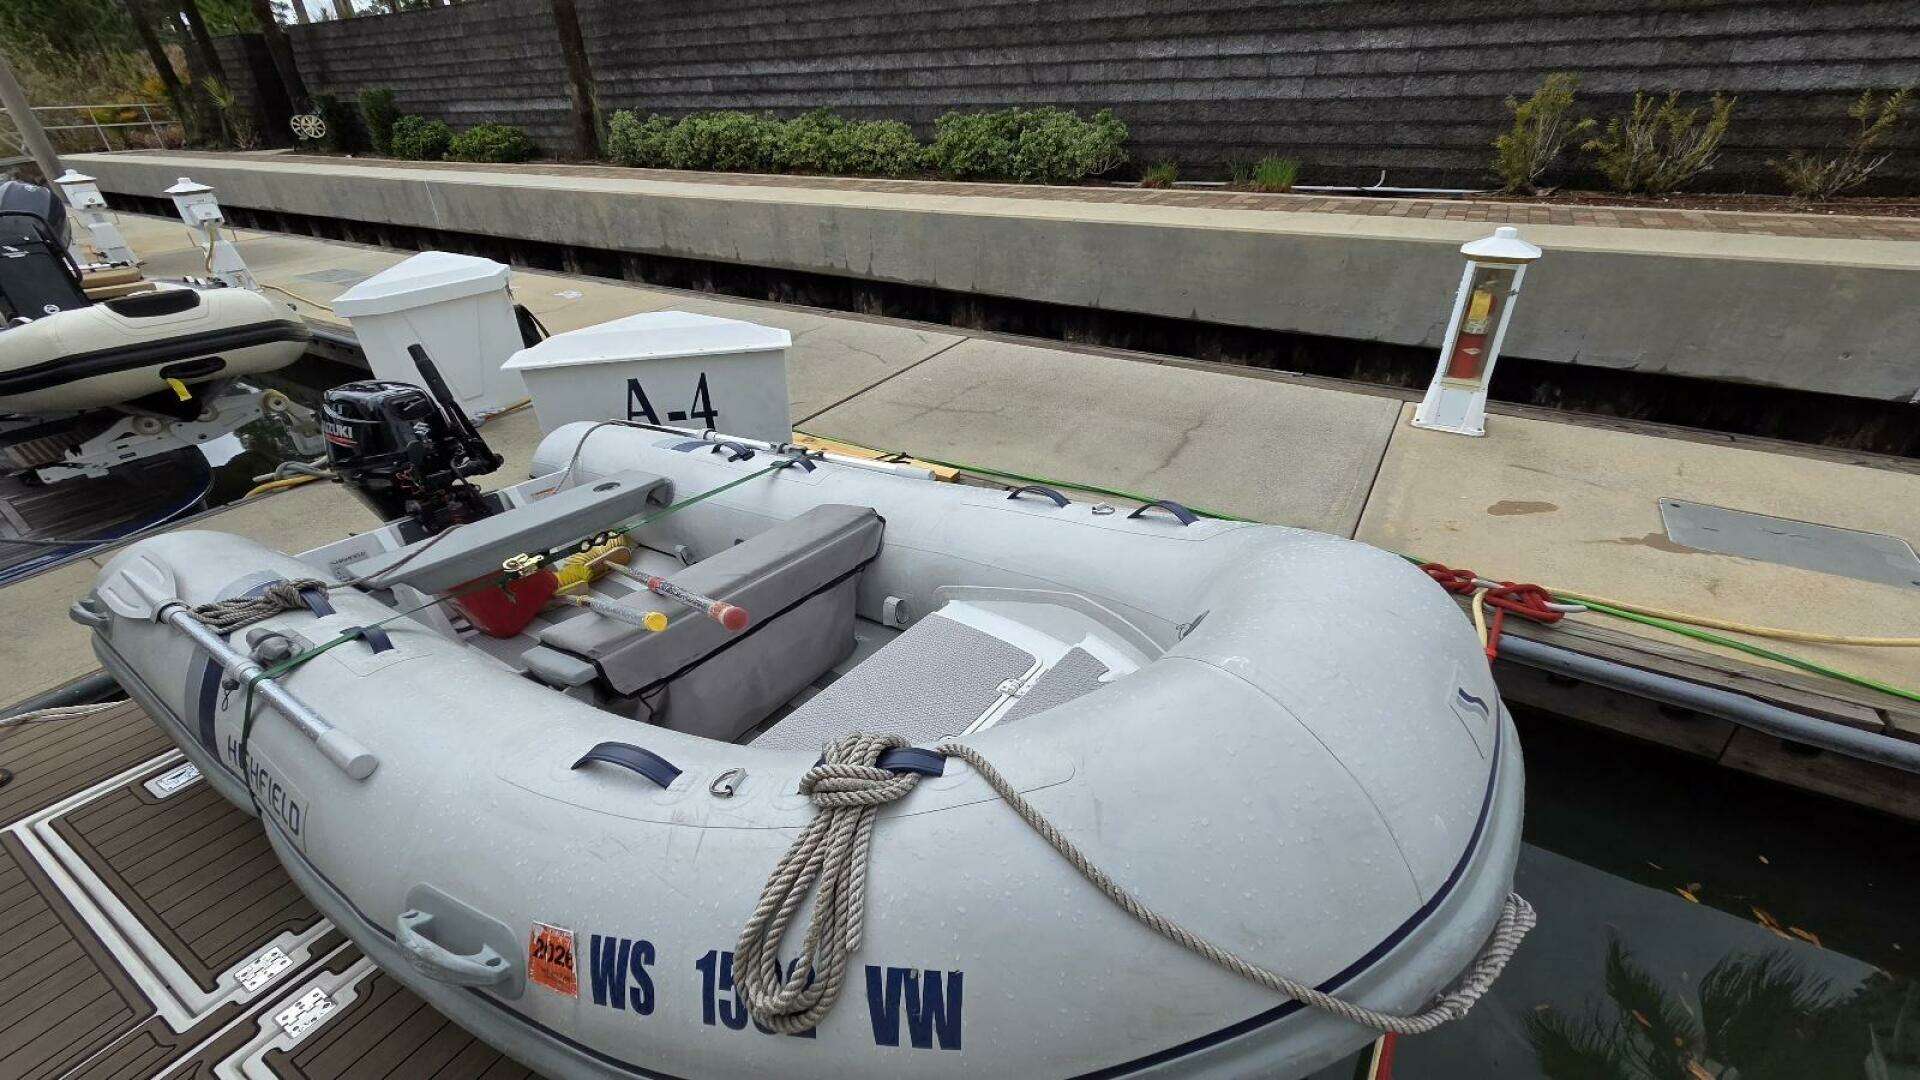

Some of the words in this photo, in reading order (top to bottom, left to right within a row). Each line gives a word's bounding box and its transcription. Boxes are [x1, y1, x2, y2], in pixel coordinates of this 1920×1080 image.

[626, 372, 718, 431] A-4
[227, 734, 300, 836] HHFIELD
[590, 934, 656, 1016] WS
[695, 949, 817, 1039] 15
[864, 965, 964, 1051] VW
